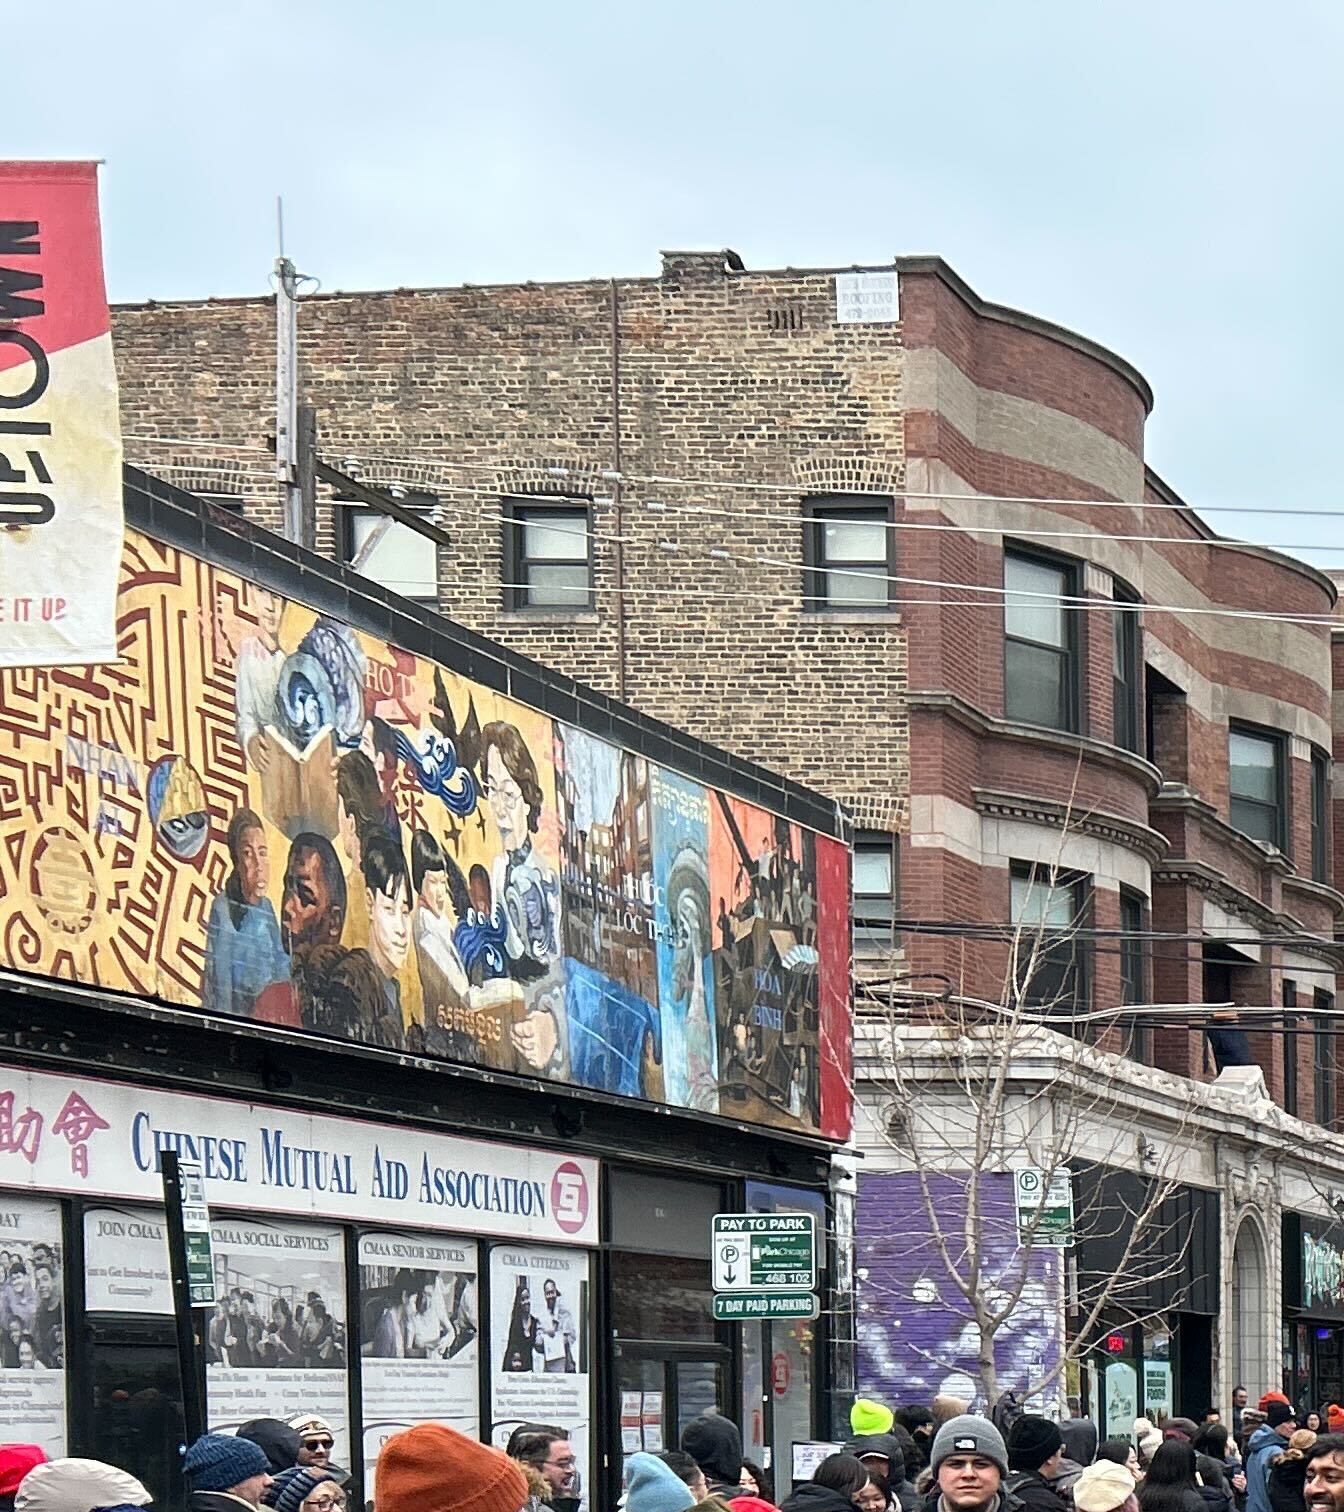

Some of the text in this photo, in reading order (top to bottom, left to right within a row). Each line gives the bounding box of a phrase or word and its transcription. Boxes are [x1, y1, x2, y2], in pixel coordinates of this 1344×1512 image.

[14, 598, 30, 621] IT
[42, 598, 66, 621] UP
[132, 1111, 546, 1218] CHINESE MUTUAL AID ASSOCIATION
[98, 1221, 163, 1240] JOIN CMAA
[720, 1218, 805, 1231] PAY TO PARK
[243, 1231, 283, 1247] SOCIAL
[284, 1235, 329, 1251] SERVICES
[392, 1244, 424, 1259] SENIOR
[425, 1247, 465, 1262] SERVICES
[765, 1273, 810, 1284] 468 102
[717, 1297, 812, 1313] 7 DAY PAID PARKING
